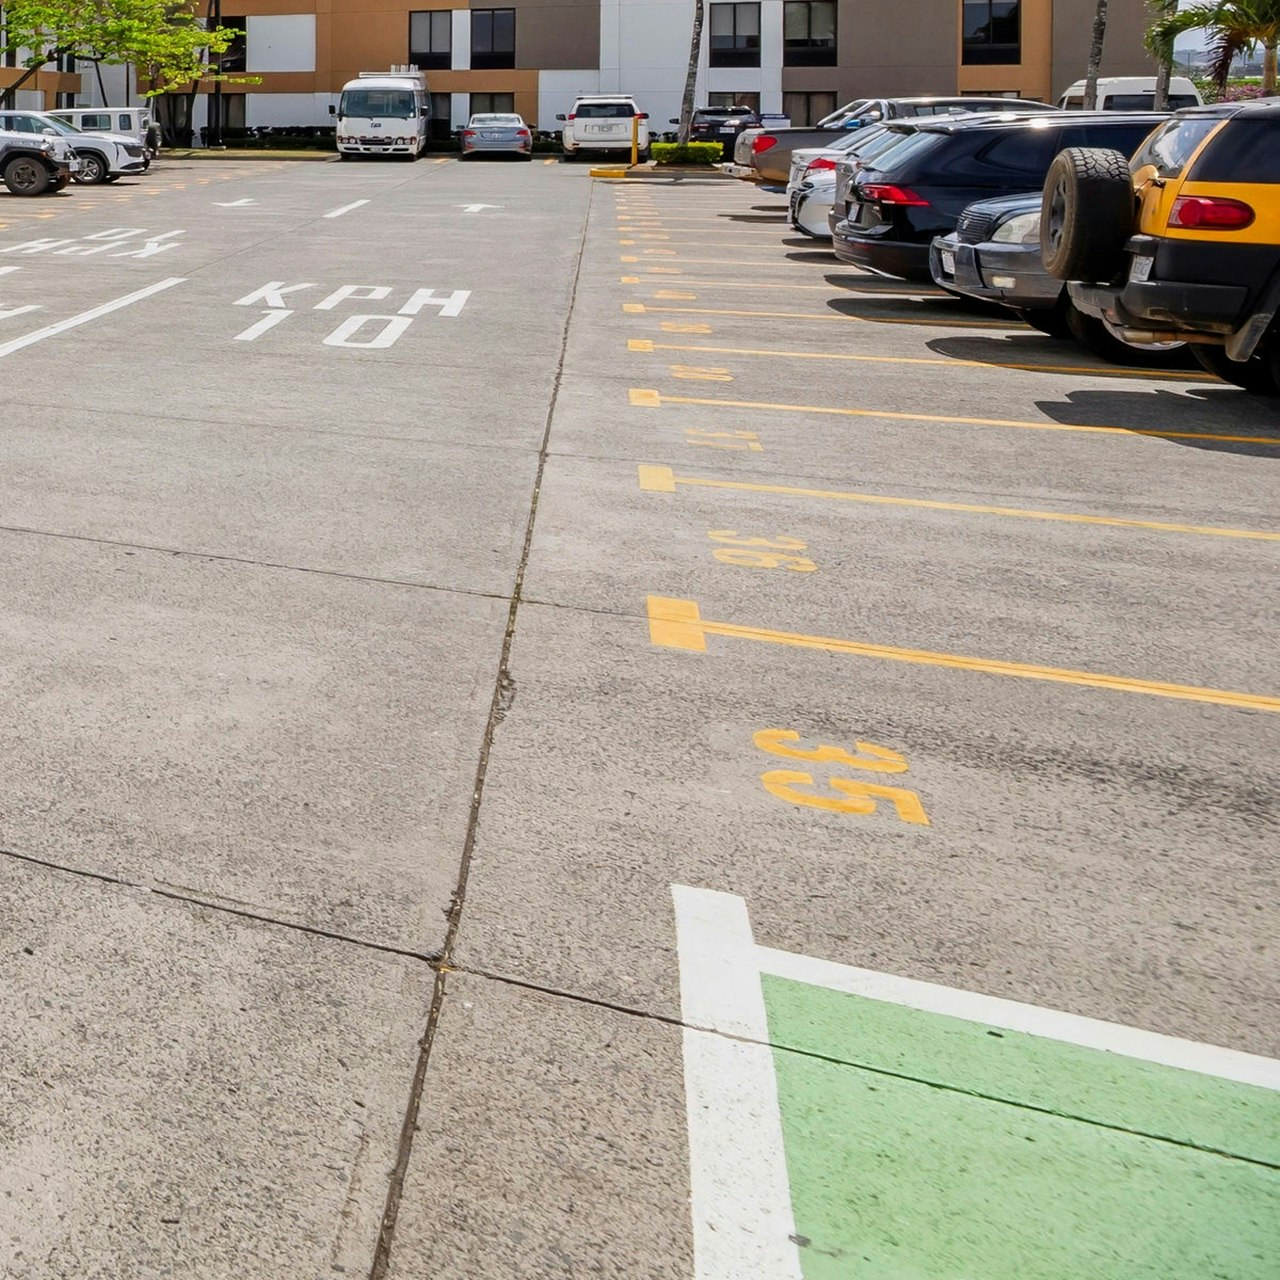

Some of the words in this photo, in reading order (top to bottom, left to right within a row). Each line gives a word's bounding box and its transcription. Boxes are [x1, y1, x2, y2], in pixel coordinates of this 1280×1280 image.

[232, 280, 473, 318] KPH
[232, 309, 416, 349] 10
[707, 529, 819, 572] 36
[752, 728, 932, 827] 35
